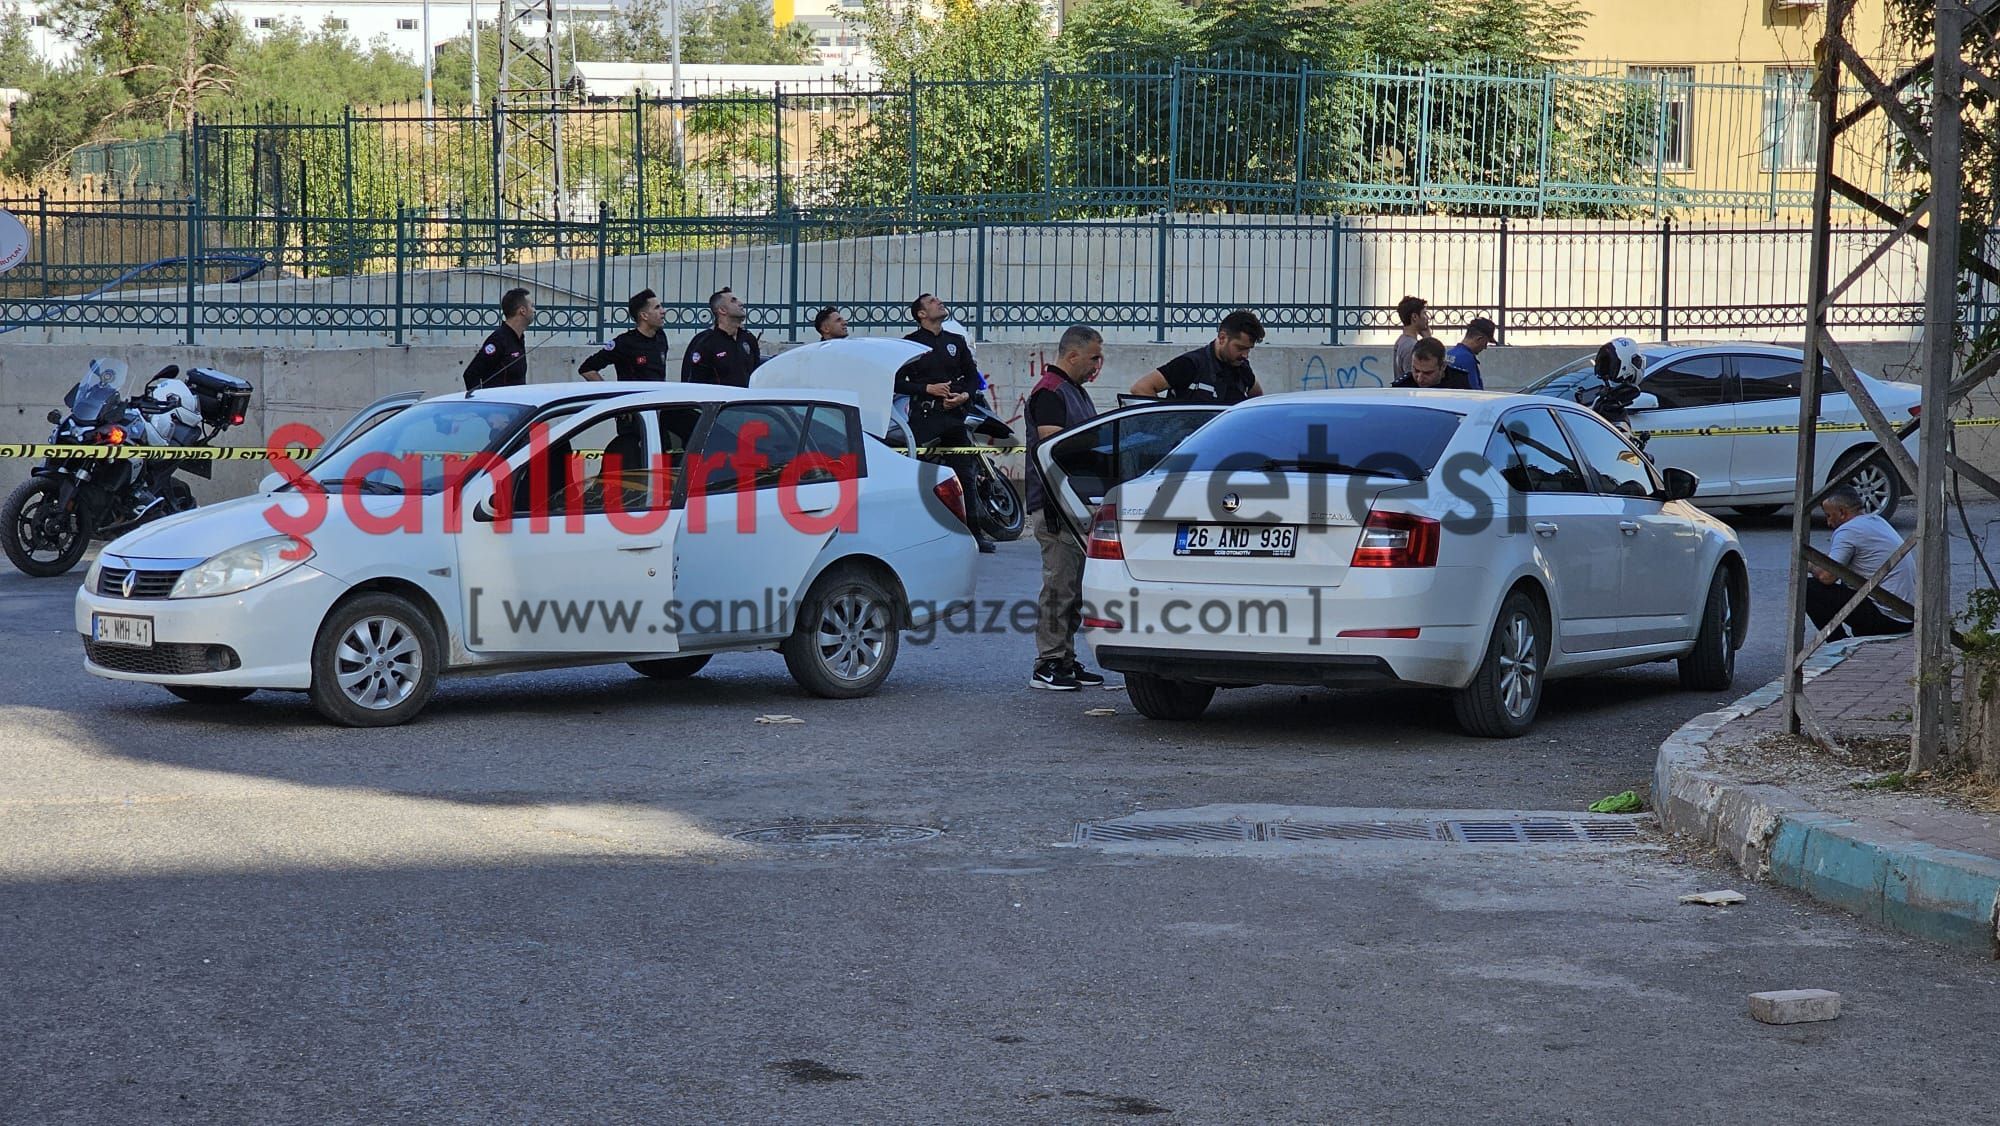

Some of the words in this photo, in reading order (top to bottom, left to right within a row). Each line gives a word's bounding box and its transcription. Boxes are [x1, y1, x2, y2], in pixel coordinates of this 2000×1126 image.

[1188, 528, 1209, 548] 26
[1218, 528, 1250, 548] AND
[1260, 528, 1292, 548] 936
[136, 621, 148, 642] 41
